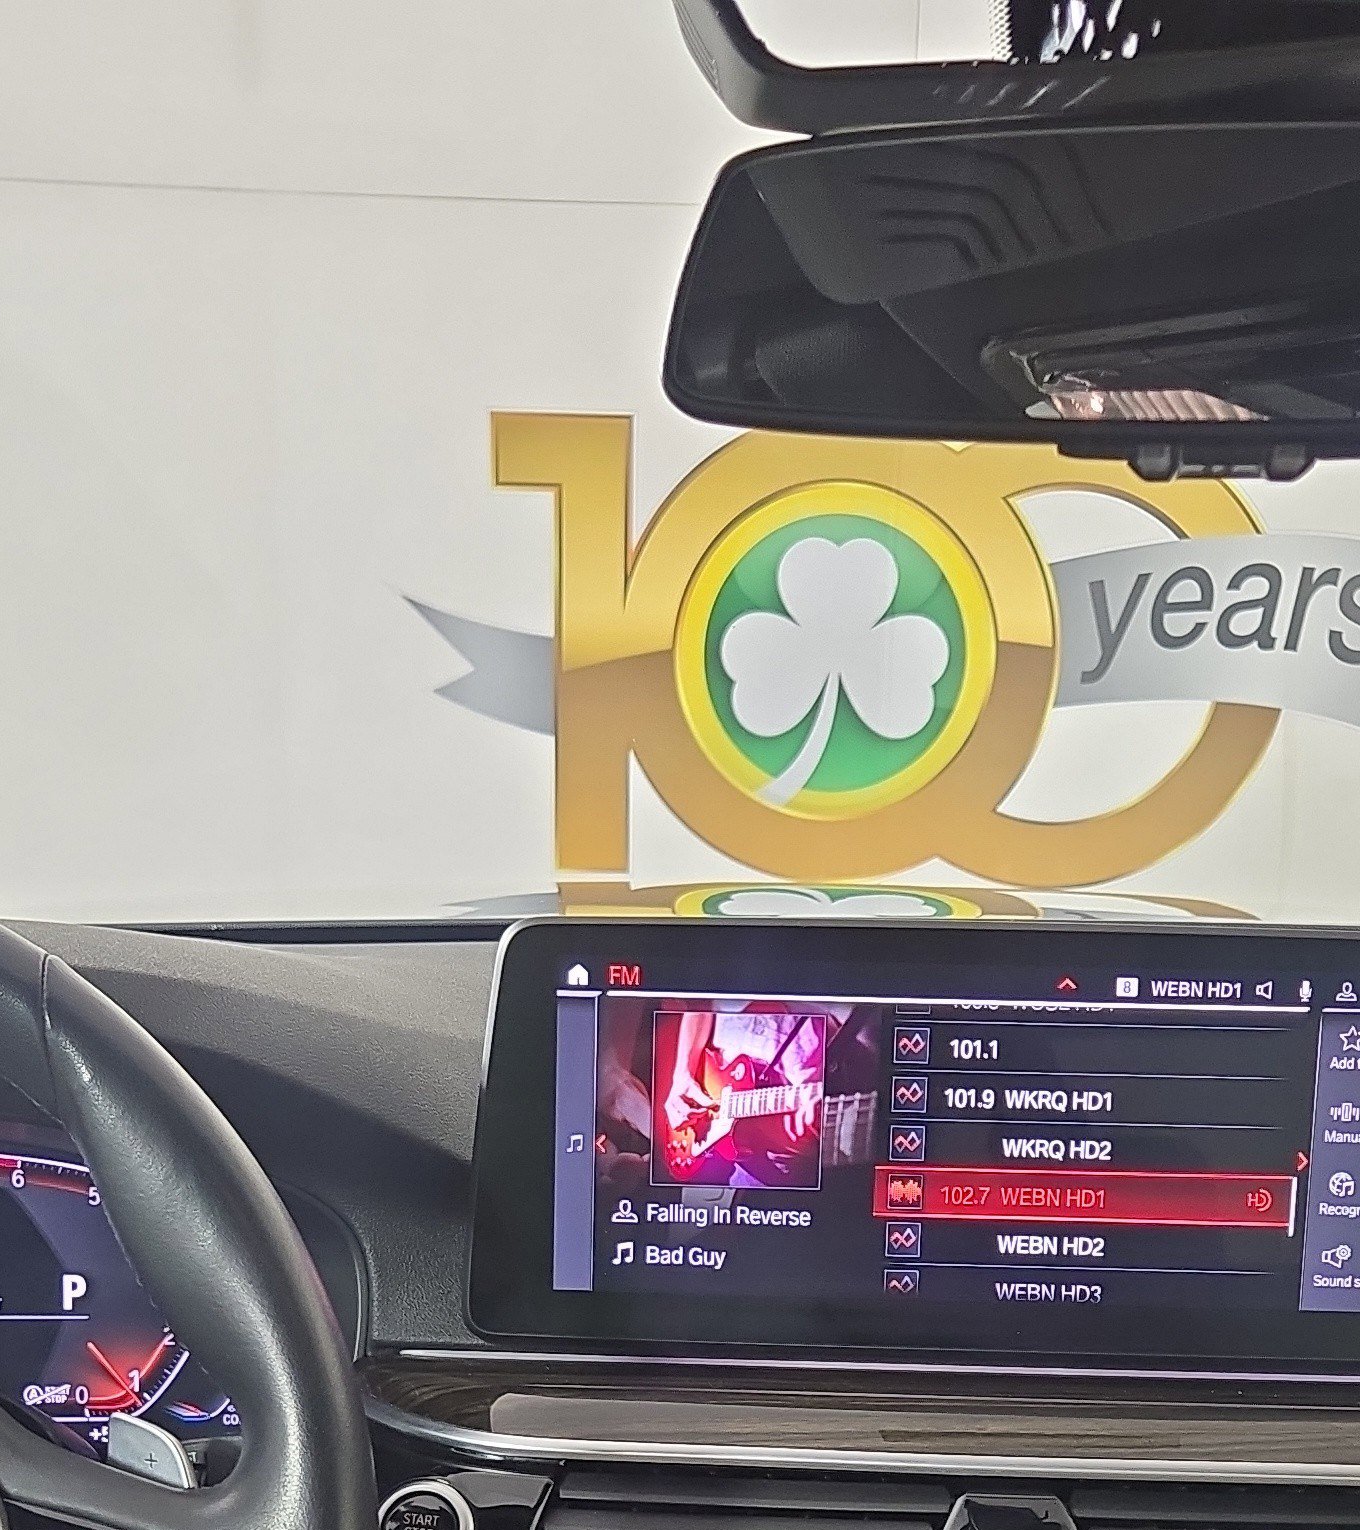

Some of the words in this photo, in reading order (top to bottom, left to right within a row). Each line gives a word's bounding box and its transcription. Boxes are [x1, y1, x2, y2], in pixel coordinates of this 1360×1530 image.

[608, 965, 641, 986] FM
[1151, 980, 1203, 998] WEBN
[1207, 982, 1242, 999] HD1
[949, 1039, 999, 1060] 101.1
[1330, 1056, 1354, 1071] Add
[944, 1088, 995, 1109] 101.9
[1005, 1090, 1067, 1113] WKRQ
[1072, 1091, 1112, 1111] HD1
[1002, 1138, 1065, 1161] WKRQ
[1069, 1140, 1112, 1161] HD2
[11, 1169, 26, 1188] 6
[87, 1186, 102, 1207] 5
[940, 1186, 991, 1205] 102.7
[1000, 1187, 1060, 1207] WEBN
[1066, 1189, 1105, 1208] HD1
[646, 1203, 708, 1227] Falling
[713, 1205, 731, 1224] In
[736, 1206, 812, 1226] Reverse
[996, 1234, 1058, 1256] WEBN
[1062, 1236, 1105, 1257] HD2
[645, 1245, 683, 1265] Bad
[689, 1247, 727, 1270] Guy
[1313, 1274, 1352, 1288] Sound
[61, 1273, 88, 1311] P
[995, 1283, 1056, 1302] WEBN
[1061, 1284, 1102, 1304] HD3
[75, 1385, 89, 1405] 0
[402, 1512, 440, 1527] START
